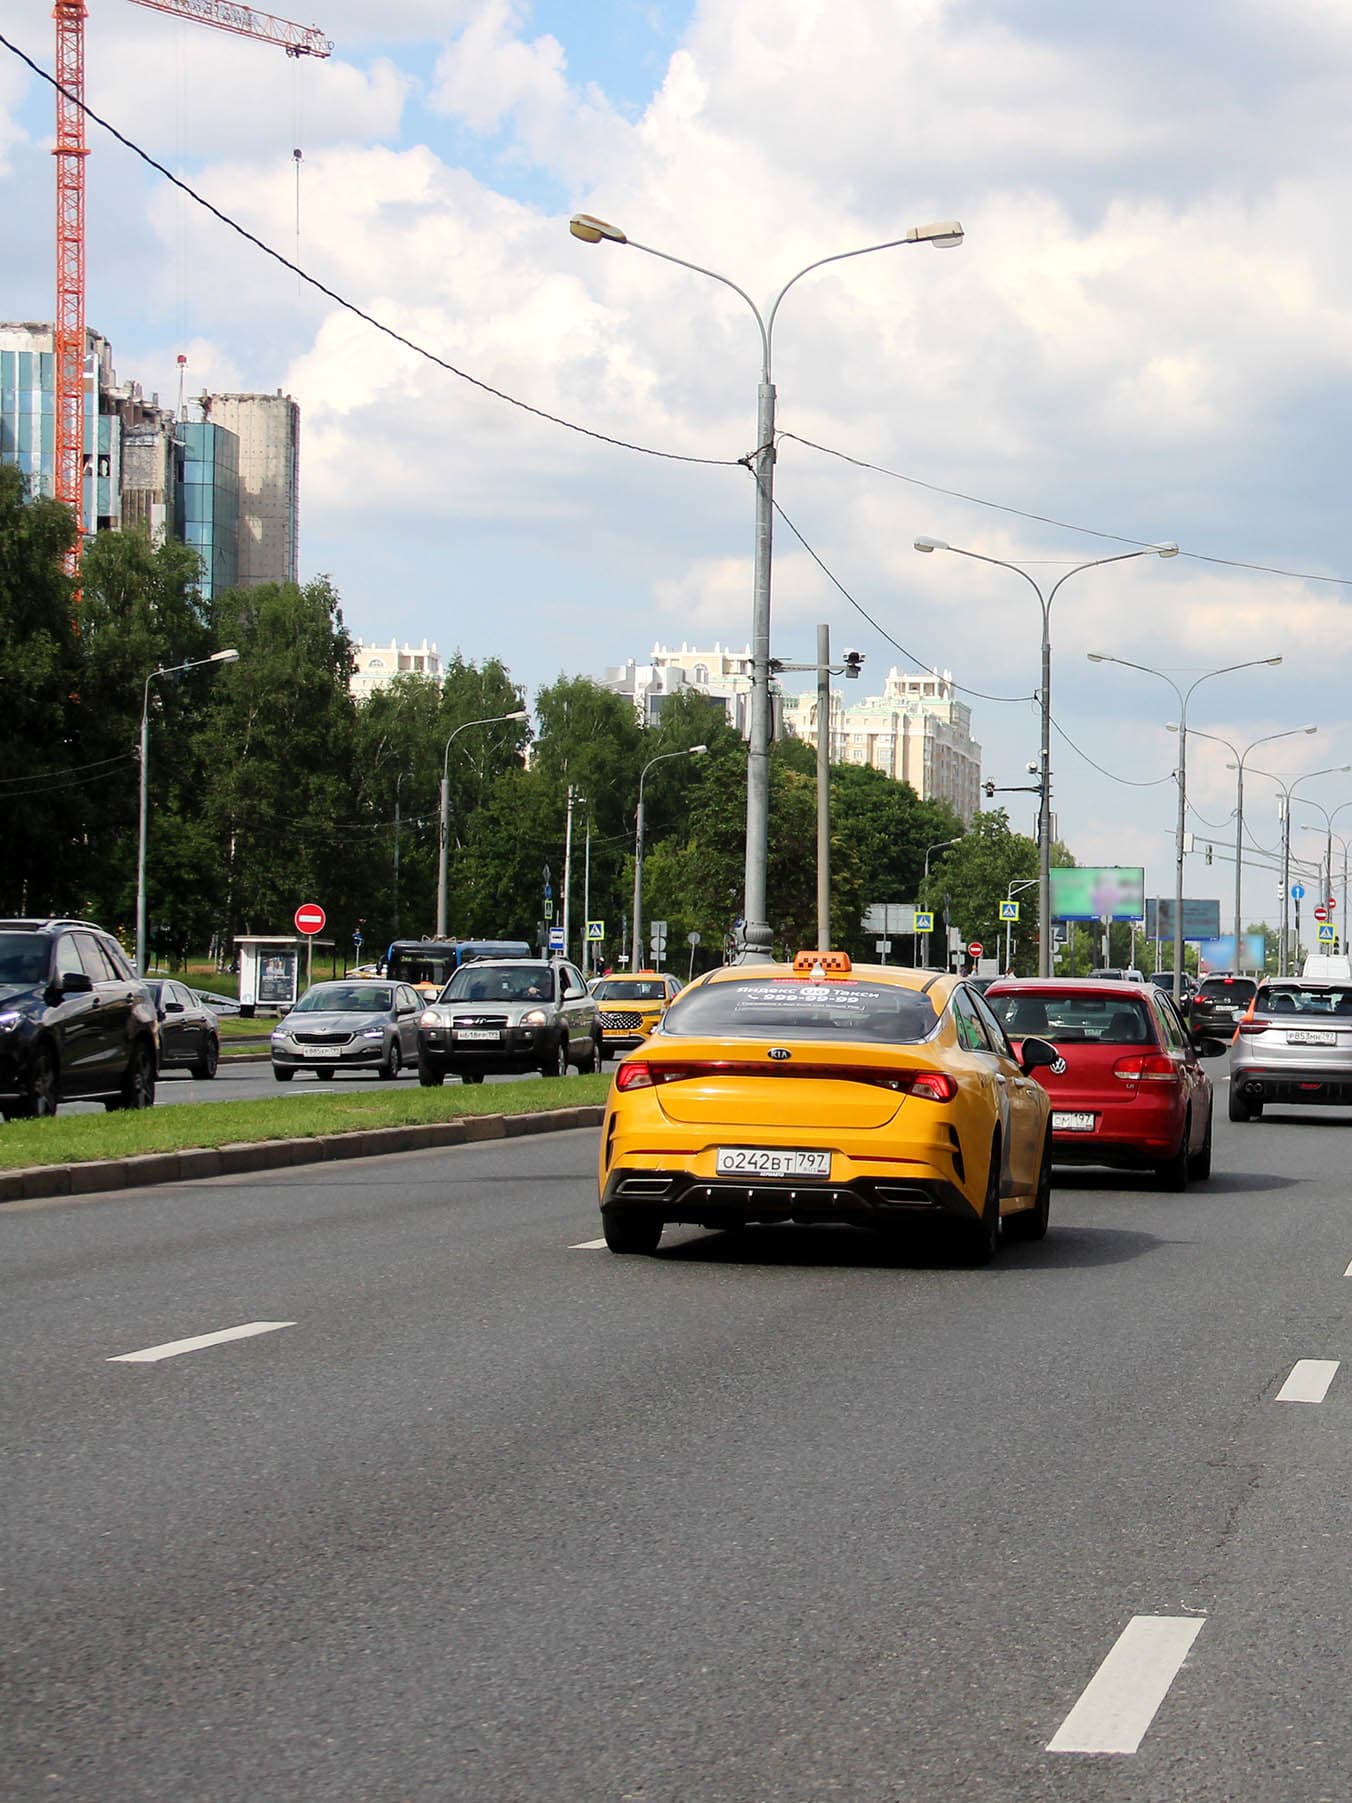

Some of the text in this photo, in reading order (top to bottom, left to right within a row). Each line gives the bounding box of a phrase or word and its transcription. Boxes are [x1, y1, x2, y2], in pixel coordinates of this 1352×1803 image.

[736, 986, 797, 994] Яндекс
[833, 989, 880, 998] Такси
[770, 1049, 788, 1059] KIA
[723, 1152, 825, 1171] О242ВТ 797
